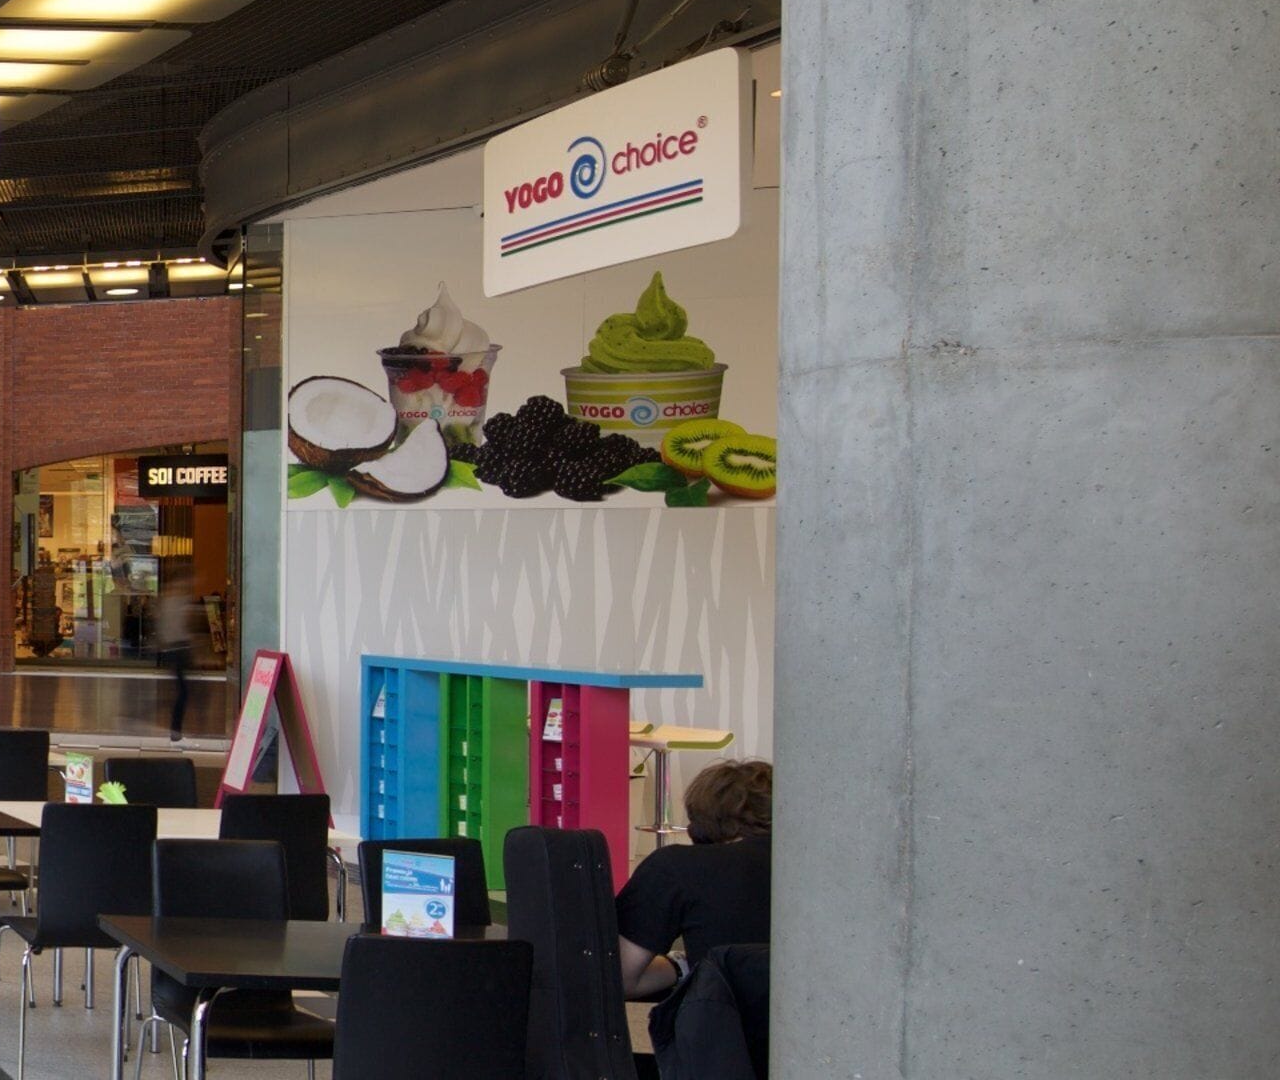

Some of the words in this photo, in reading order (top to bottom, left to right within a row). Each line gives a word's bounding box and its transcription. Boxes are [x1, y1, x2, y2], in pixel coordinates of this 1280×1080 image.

[504, 170, 564, 214] YOGO
[611, 130, 698, 175] choice
[399, 410, 429, 419] YOGO
[447, 406, 478, 418] choice
[579, 404, 625, 419] YOGO
[663, 402, 710, 418] choice
[175, 466, 228, 485] COFFEE
